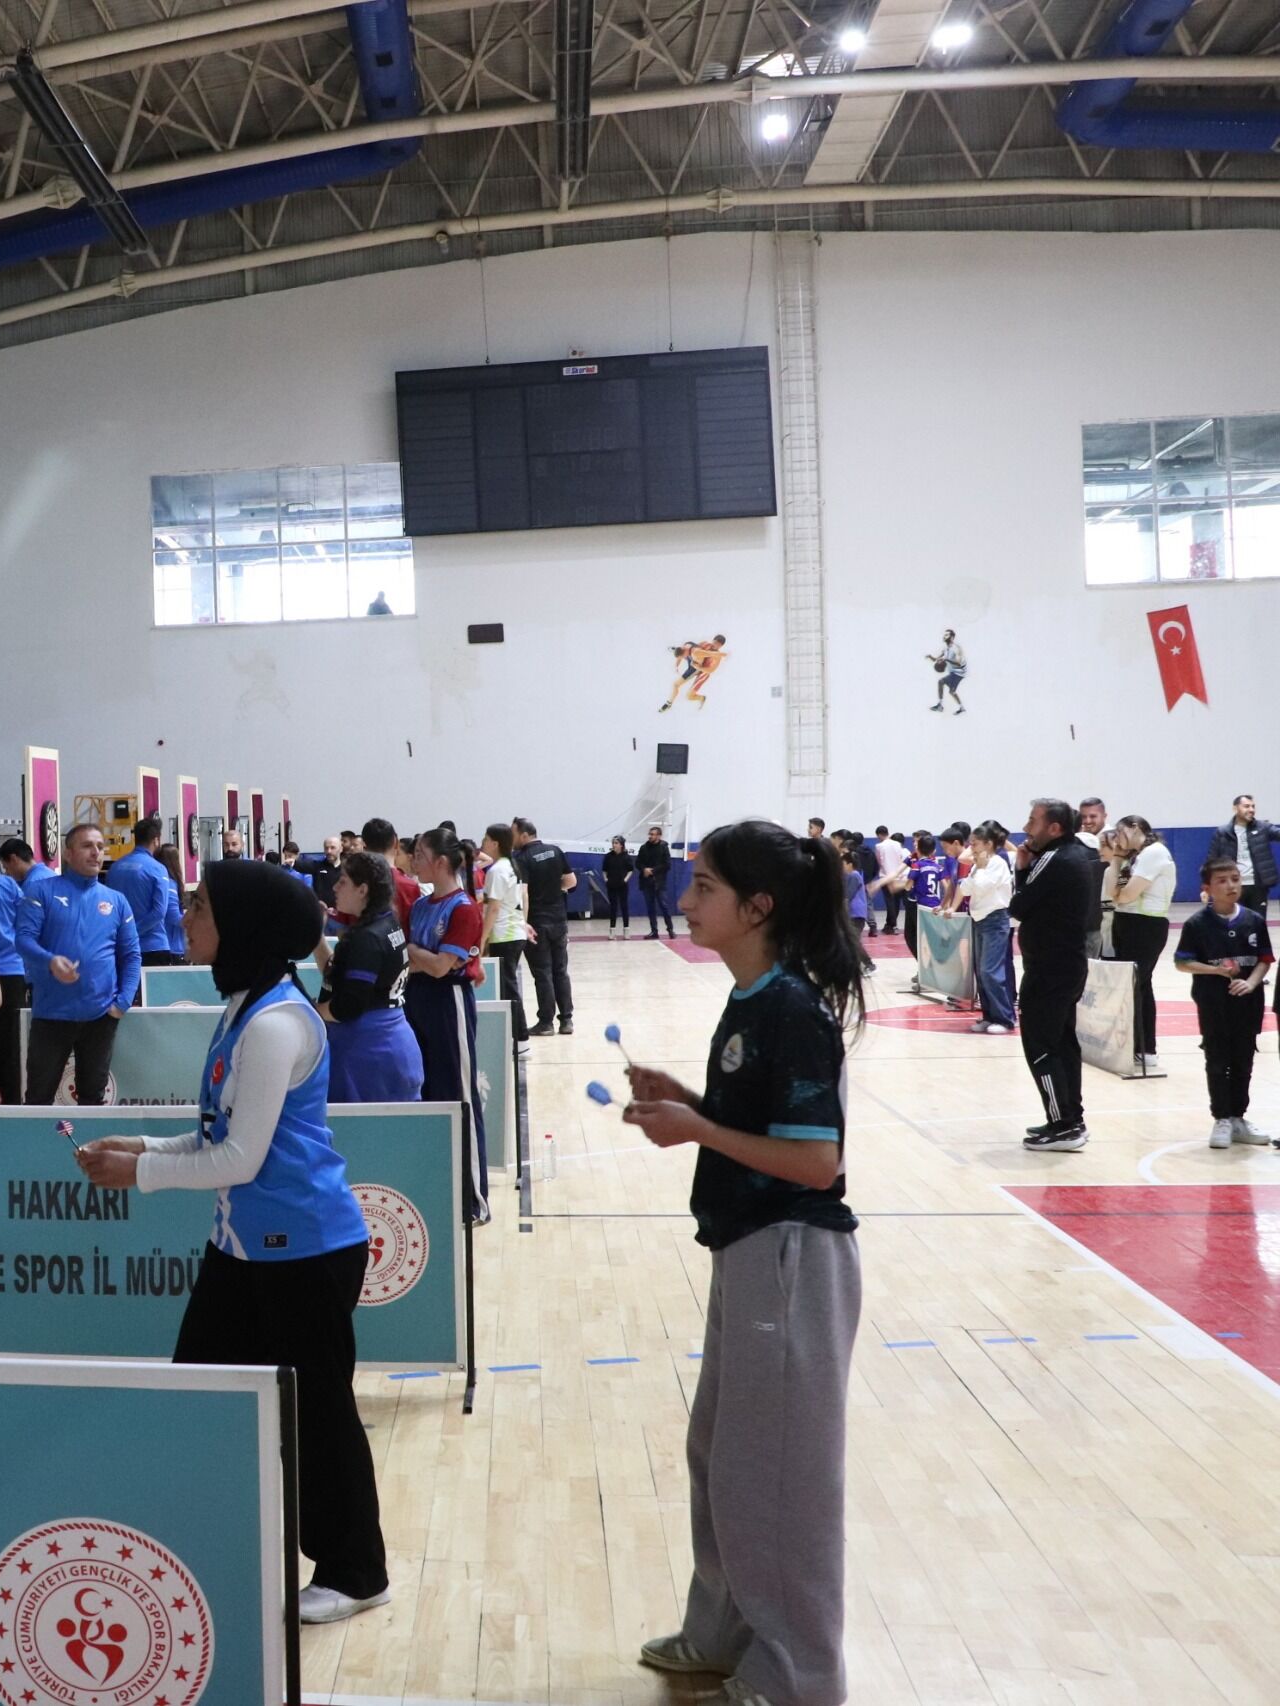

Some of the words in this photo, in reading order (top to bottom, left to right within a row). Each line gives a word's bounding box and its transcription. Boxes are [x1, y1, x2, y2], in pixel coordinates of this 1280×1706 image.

[927, 873, 936, 896] 5
[387, 1215, 395, 1227] VE
[393, 1225, 404, 1246] SPOR
[14, 1254, 85, 1295] SPOR
[94, 1246, 117, 1296] İL
[126, 1248, 204, 1297] MÜDÜ
[70, 1564, 133, 1588] GENÇLİK
[132, 1584, 148, 1604] VE
[20, 1567, 67, 1653] CUMHURİYETİ
[145, 1602, 166, 1642] SPOR
[25, 1656, 77, 1702] TÜRKİYE
[113, 1642, 166, 1703] BAKANLIĞI
